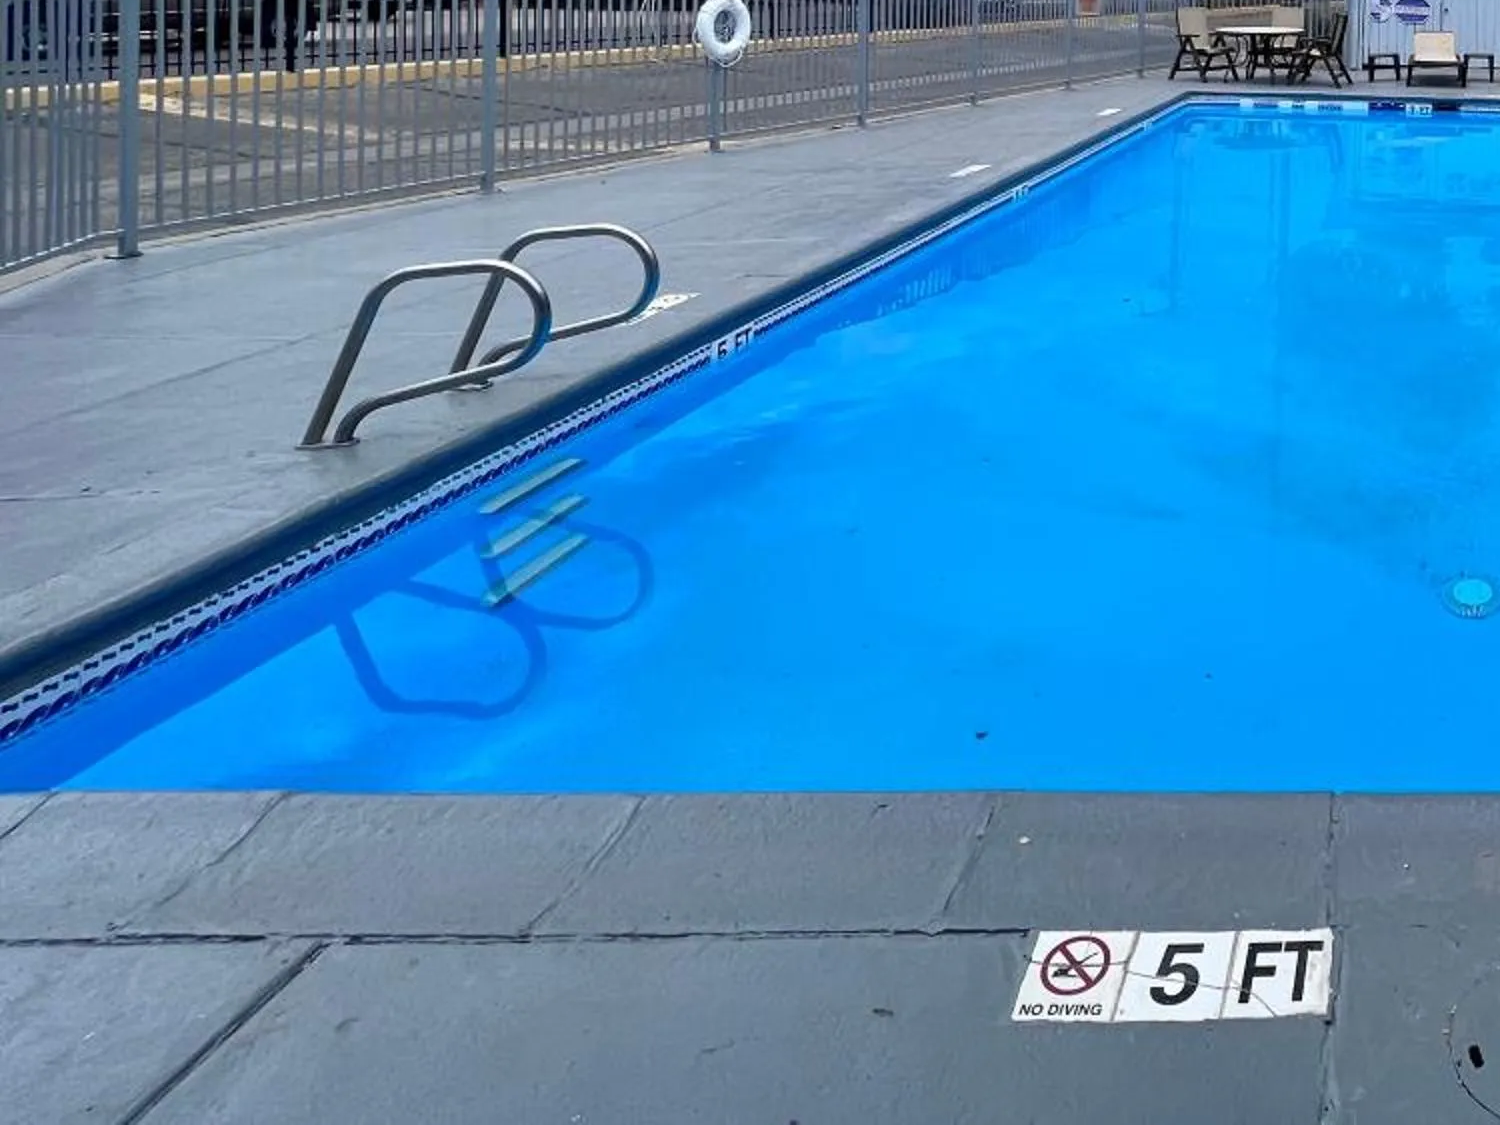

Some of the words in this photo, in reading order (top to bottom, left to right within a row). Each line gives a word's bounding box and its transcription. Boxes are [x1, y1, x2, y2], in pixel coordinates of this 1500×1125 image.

[1149, 941, 1205, 1006] 5
[1237, 940, 1325, 1004] FT
[1018, 1004, 1044, 1016] NO
[1047, 1004, 1103, 1017] DIVING
